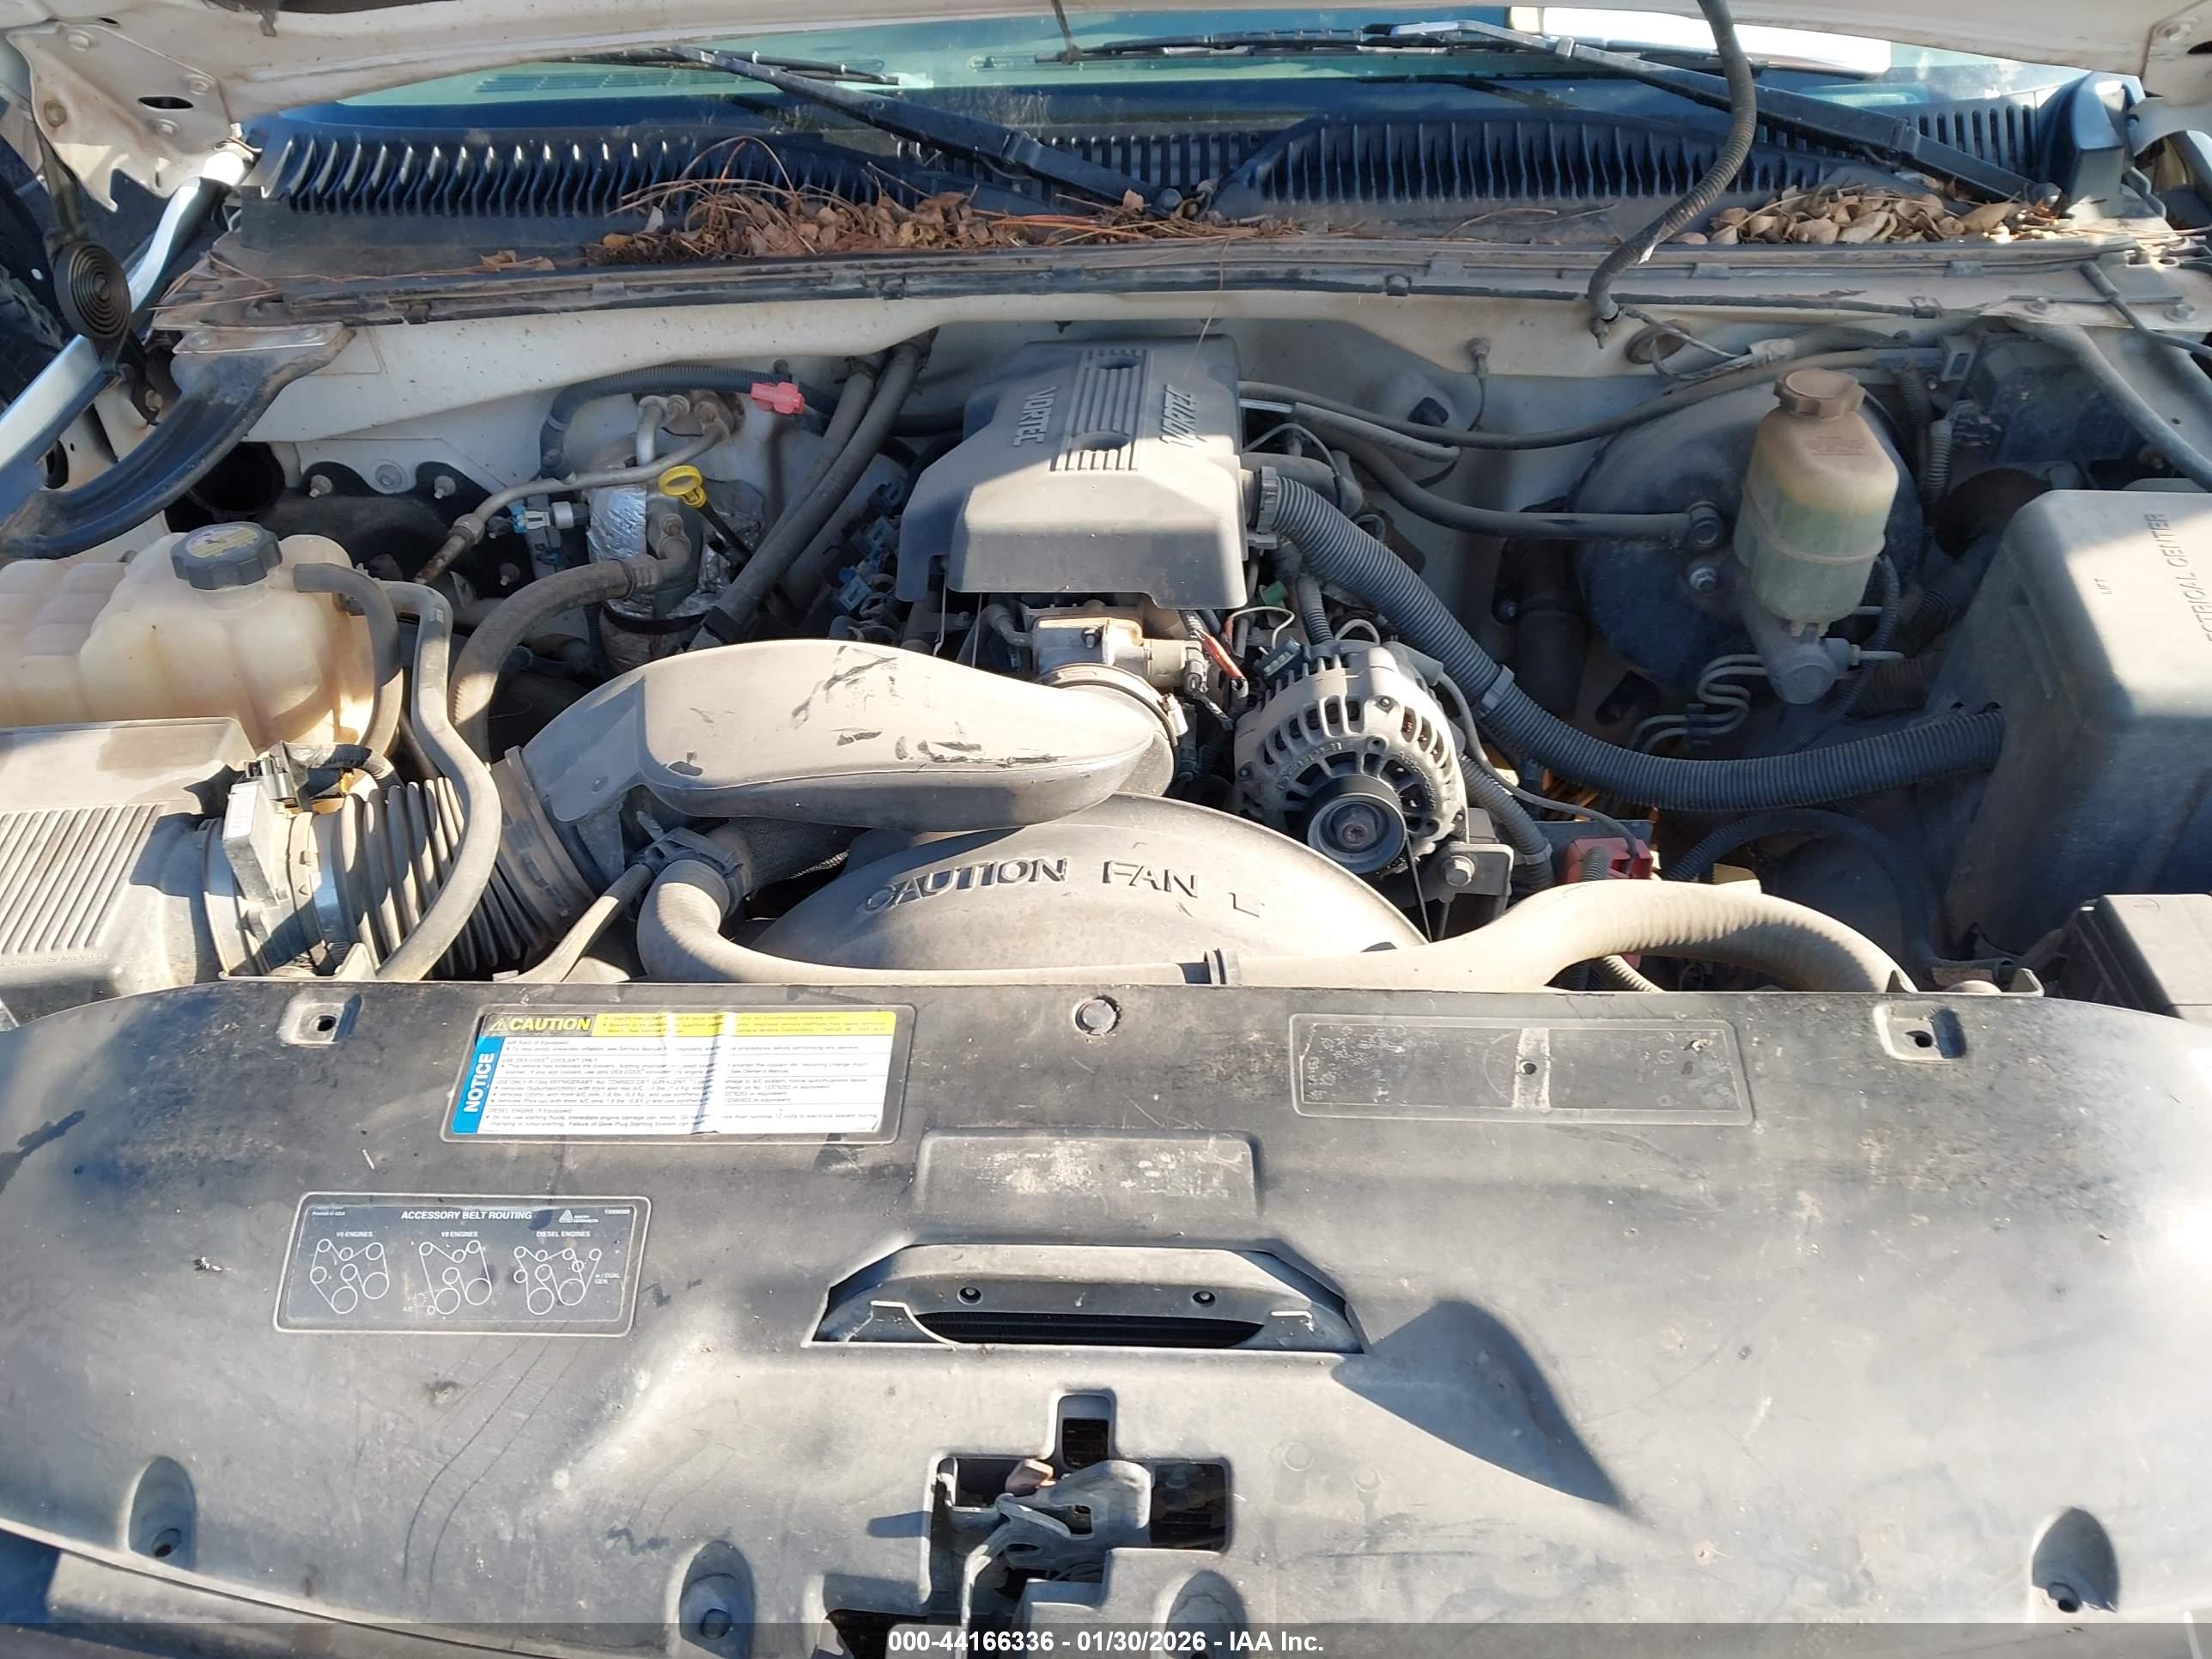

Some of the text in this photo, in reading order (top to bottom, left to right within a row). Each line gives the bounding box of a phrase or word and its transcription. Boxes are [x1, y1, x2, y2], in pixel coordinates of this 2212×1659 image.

[1012, 386, 1058, 447] VORTEC
[2143, 514, 2189, 568] CENTER
[859, 858, 1199, 915] CAUTION FAN
[508, 1017, 592, 1031] CAUTION
[463, 1052, 495, 1113] NOTICE
[401, 1211, 532, 1219] ACCESSORY BELT ROUTING
